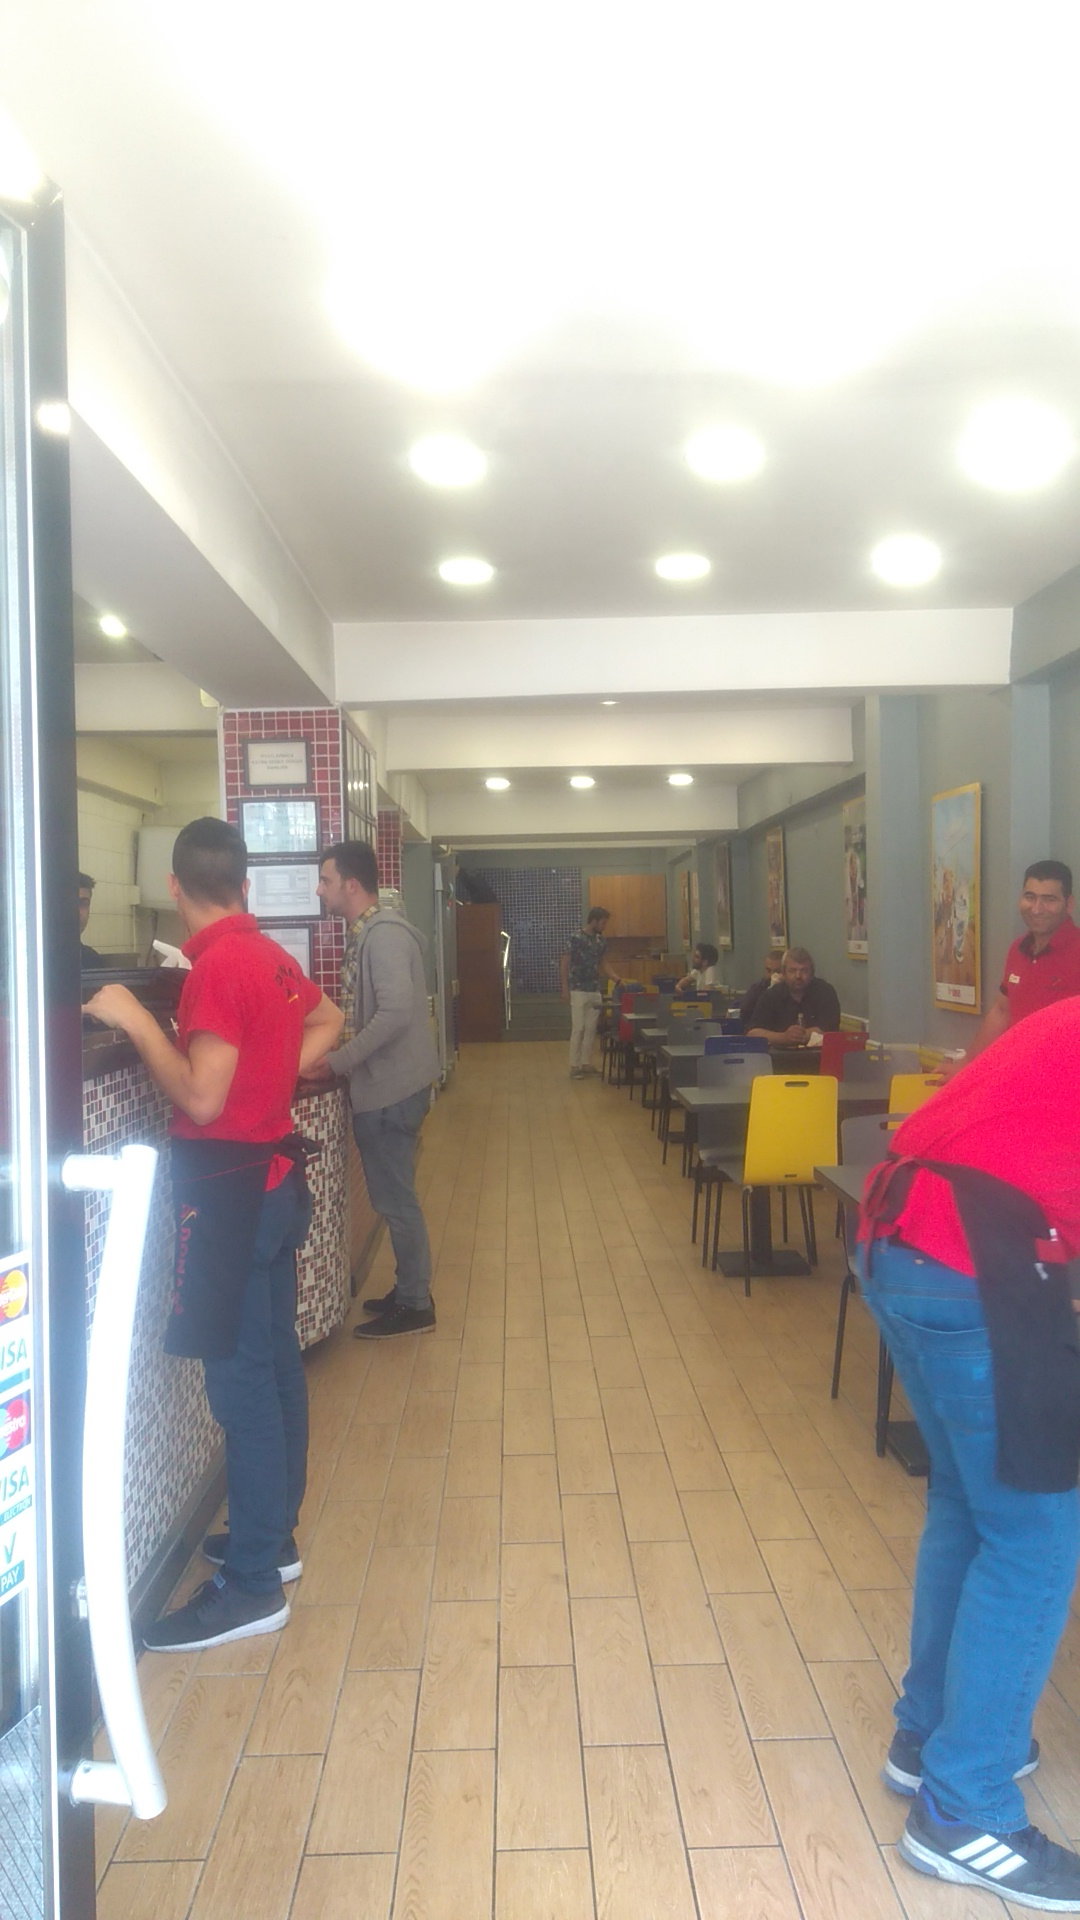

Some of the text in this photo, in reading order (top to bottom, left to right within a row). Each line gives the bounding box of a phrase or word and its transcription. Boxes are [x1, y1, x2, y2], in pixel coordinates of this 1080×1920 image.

[0, 1338, 27, 1370] ISA
[0, 1465, 29, 1502] ISA
[4, 1532, 17, 1564] V
[1, 1565, 19, 1594] PAY
